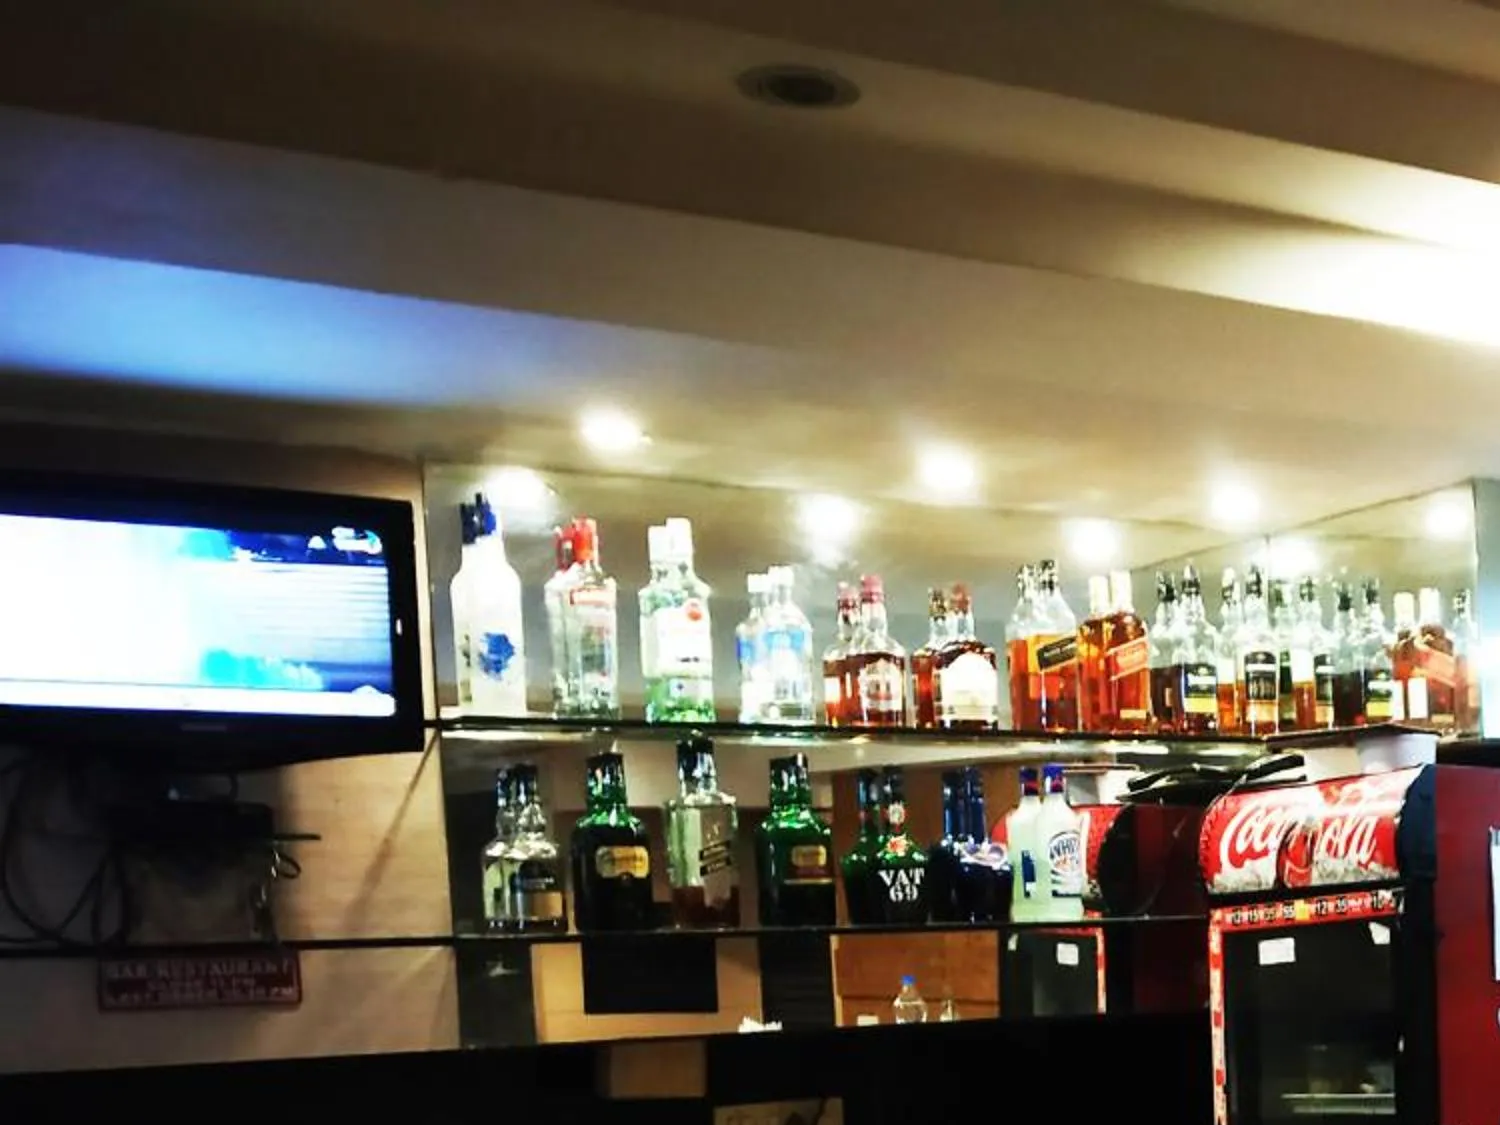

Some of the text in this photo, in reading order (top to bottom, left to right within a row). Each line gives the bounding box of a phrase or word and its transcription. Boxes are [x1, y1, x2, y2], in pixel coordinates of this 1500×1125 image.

[1219, 797, 1380, 870] Cocaola
[877, 867, 925, 887] VAT
[889, 884, 918, 902] 69
